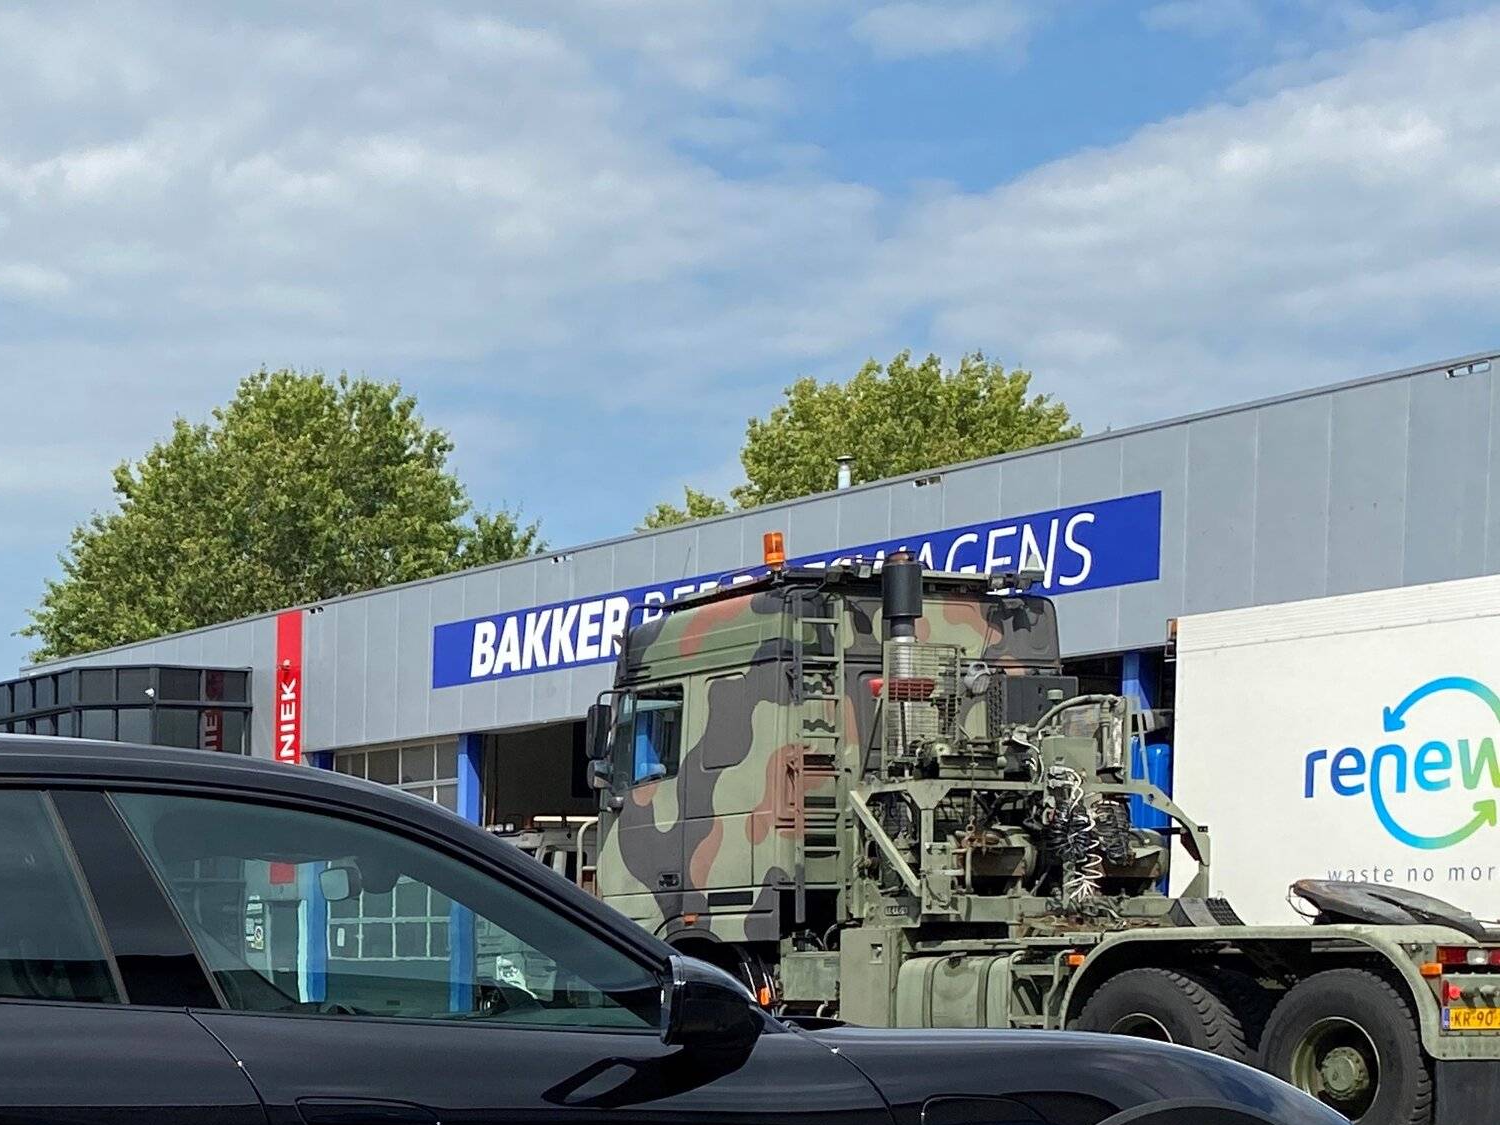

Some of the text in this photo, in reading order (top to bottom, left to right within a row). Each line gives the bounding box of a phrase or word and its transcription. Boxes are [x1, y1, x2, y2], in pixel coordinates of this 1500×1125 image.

[470, 597, 630, 678] BAKKER
[279, 678, 297, 765] NIEK
[1327, 866, 1394, 883] waste
[1407, 867, 1434, 883] no
